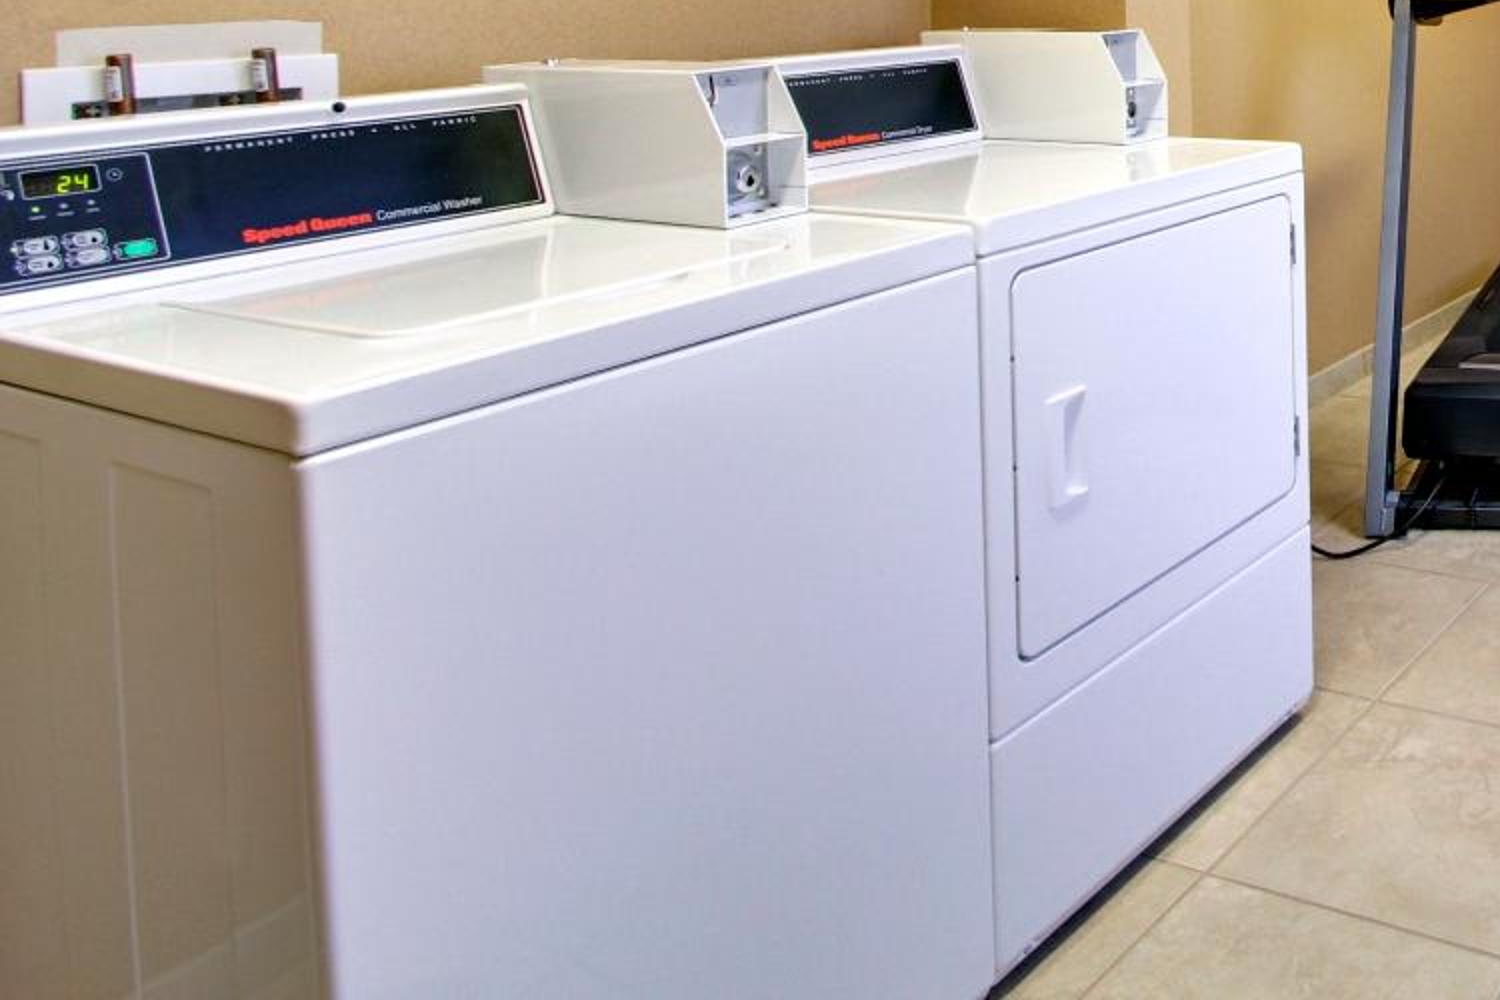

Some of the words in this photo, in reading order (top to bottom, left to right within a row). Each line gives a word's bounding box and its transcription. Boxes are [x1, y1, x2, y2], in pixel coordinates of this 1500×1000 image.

[432, 115, 478, 127] FABRIC
[57, 173, 88, 193] 24
[242, 221, 308, 244] Speed
[310, 212, 373, 230] Queen
[375, 201, 441, 222] Commercial
[442, 195, 483, 210] Washer
